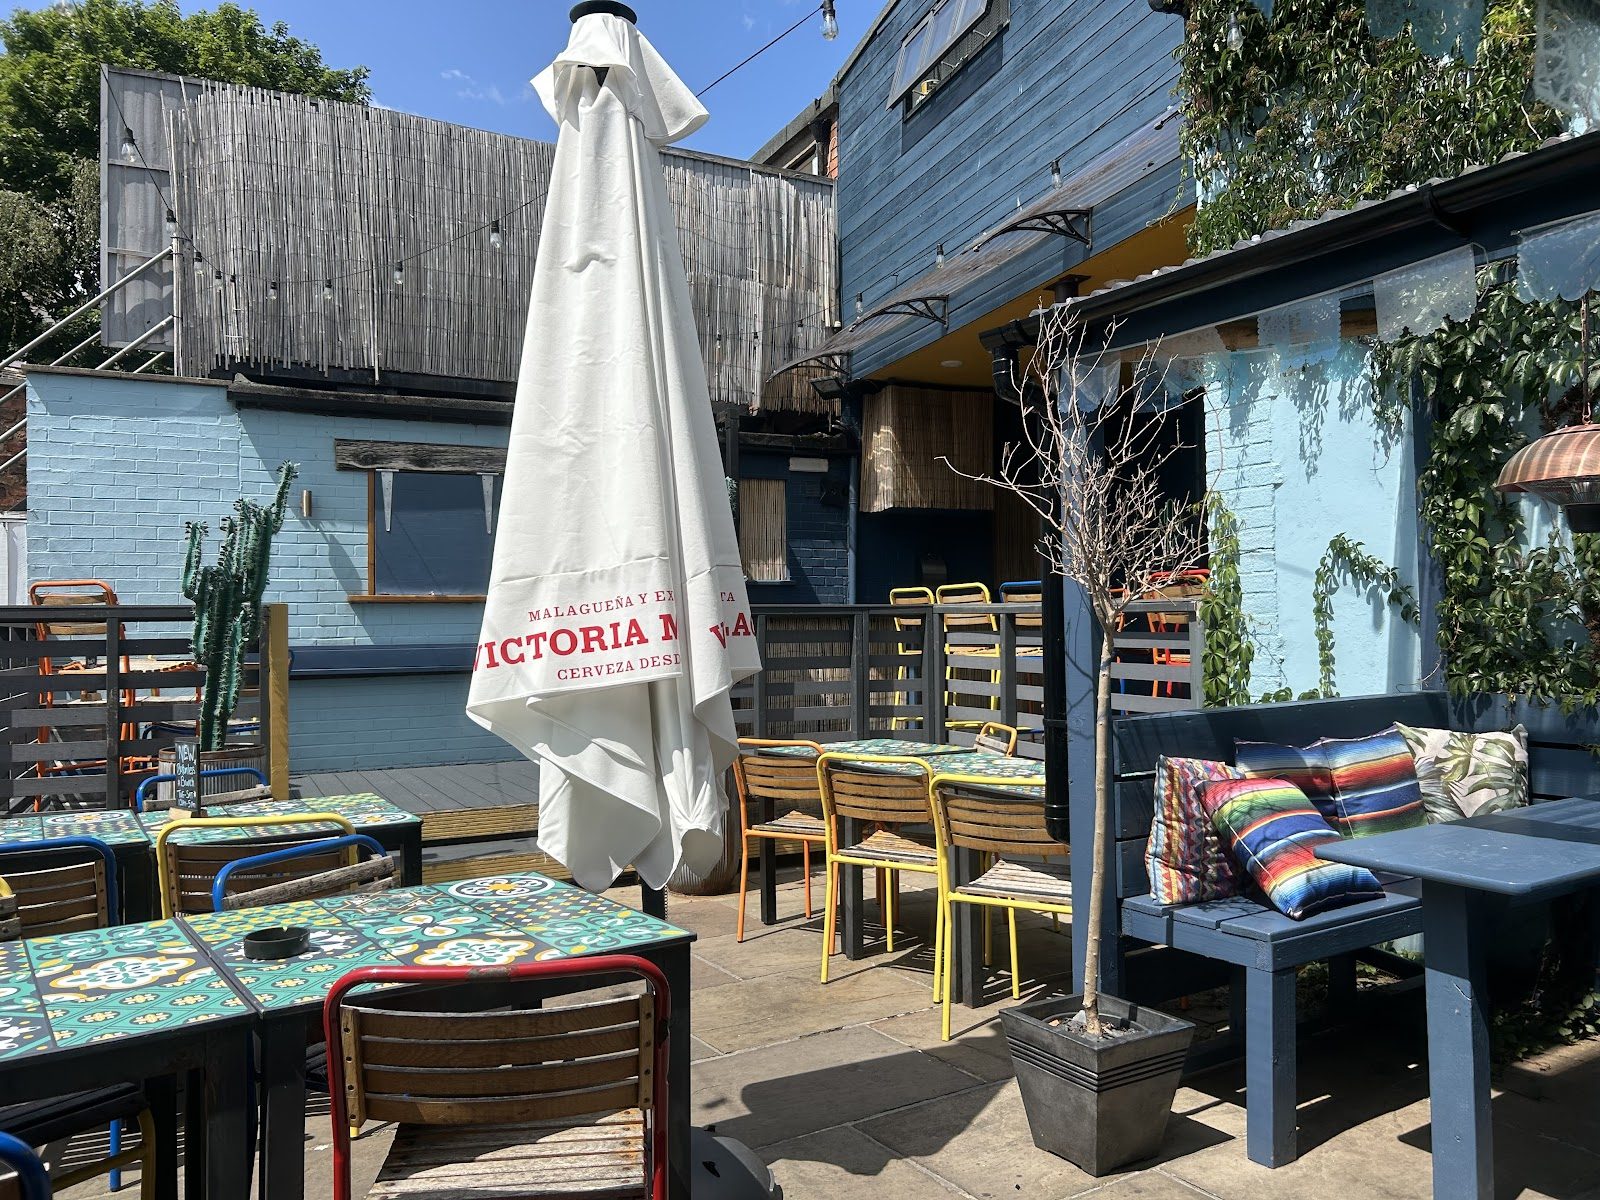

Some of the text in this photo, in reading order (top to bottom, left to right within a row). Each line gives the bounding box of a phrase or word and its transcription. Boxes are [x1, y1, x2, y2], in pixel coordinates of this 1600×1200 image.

[528, 596, 634, 622] MALAGUEÑA
[638, 592, 648, 605] Y
[557, 659, 635, 681] CERVEZA
